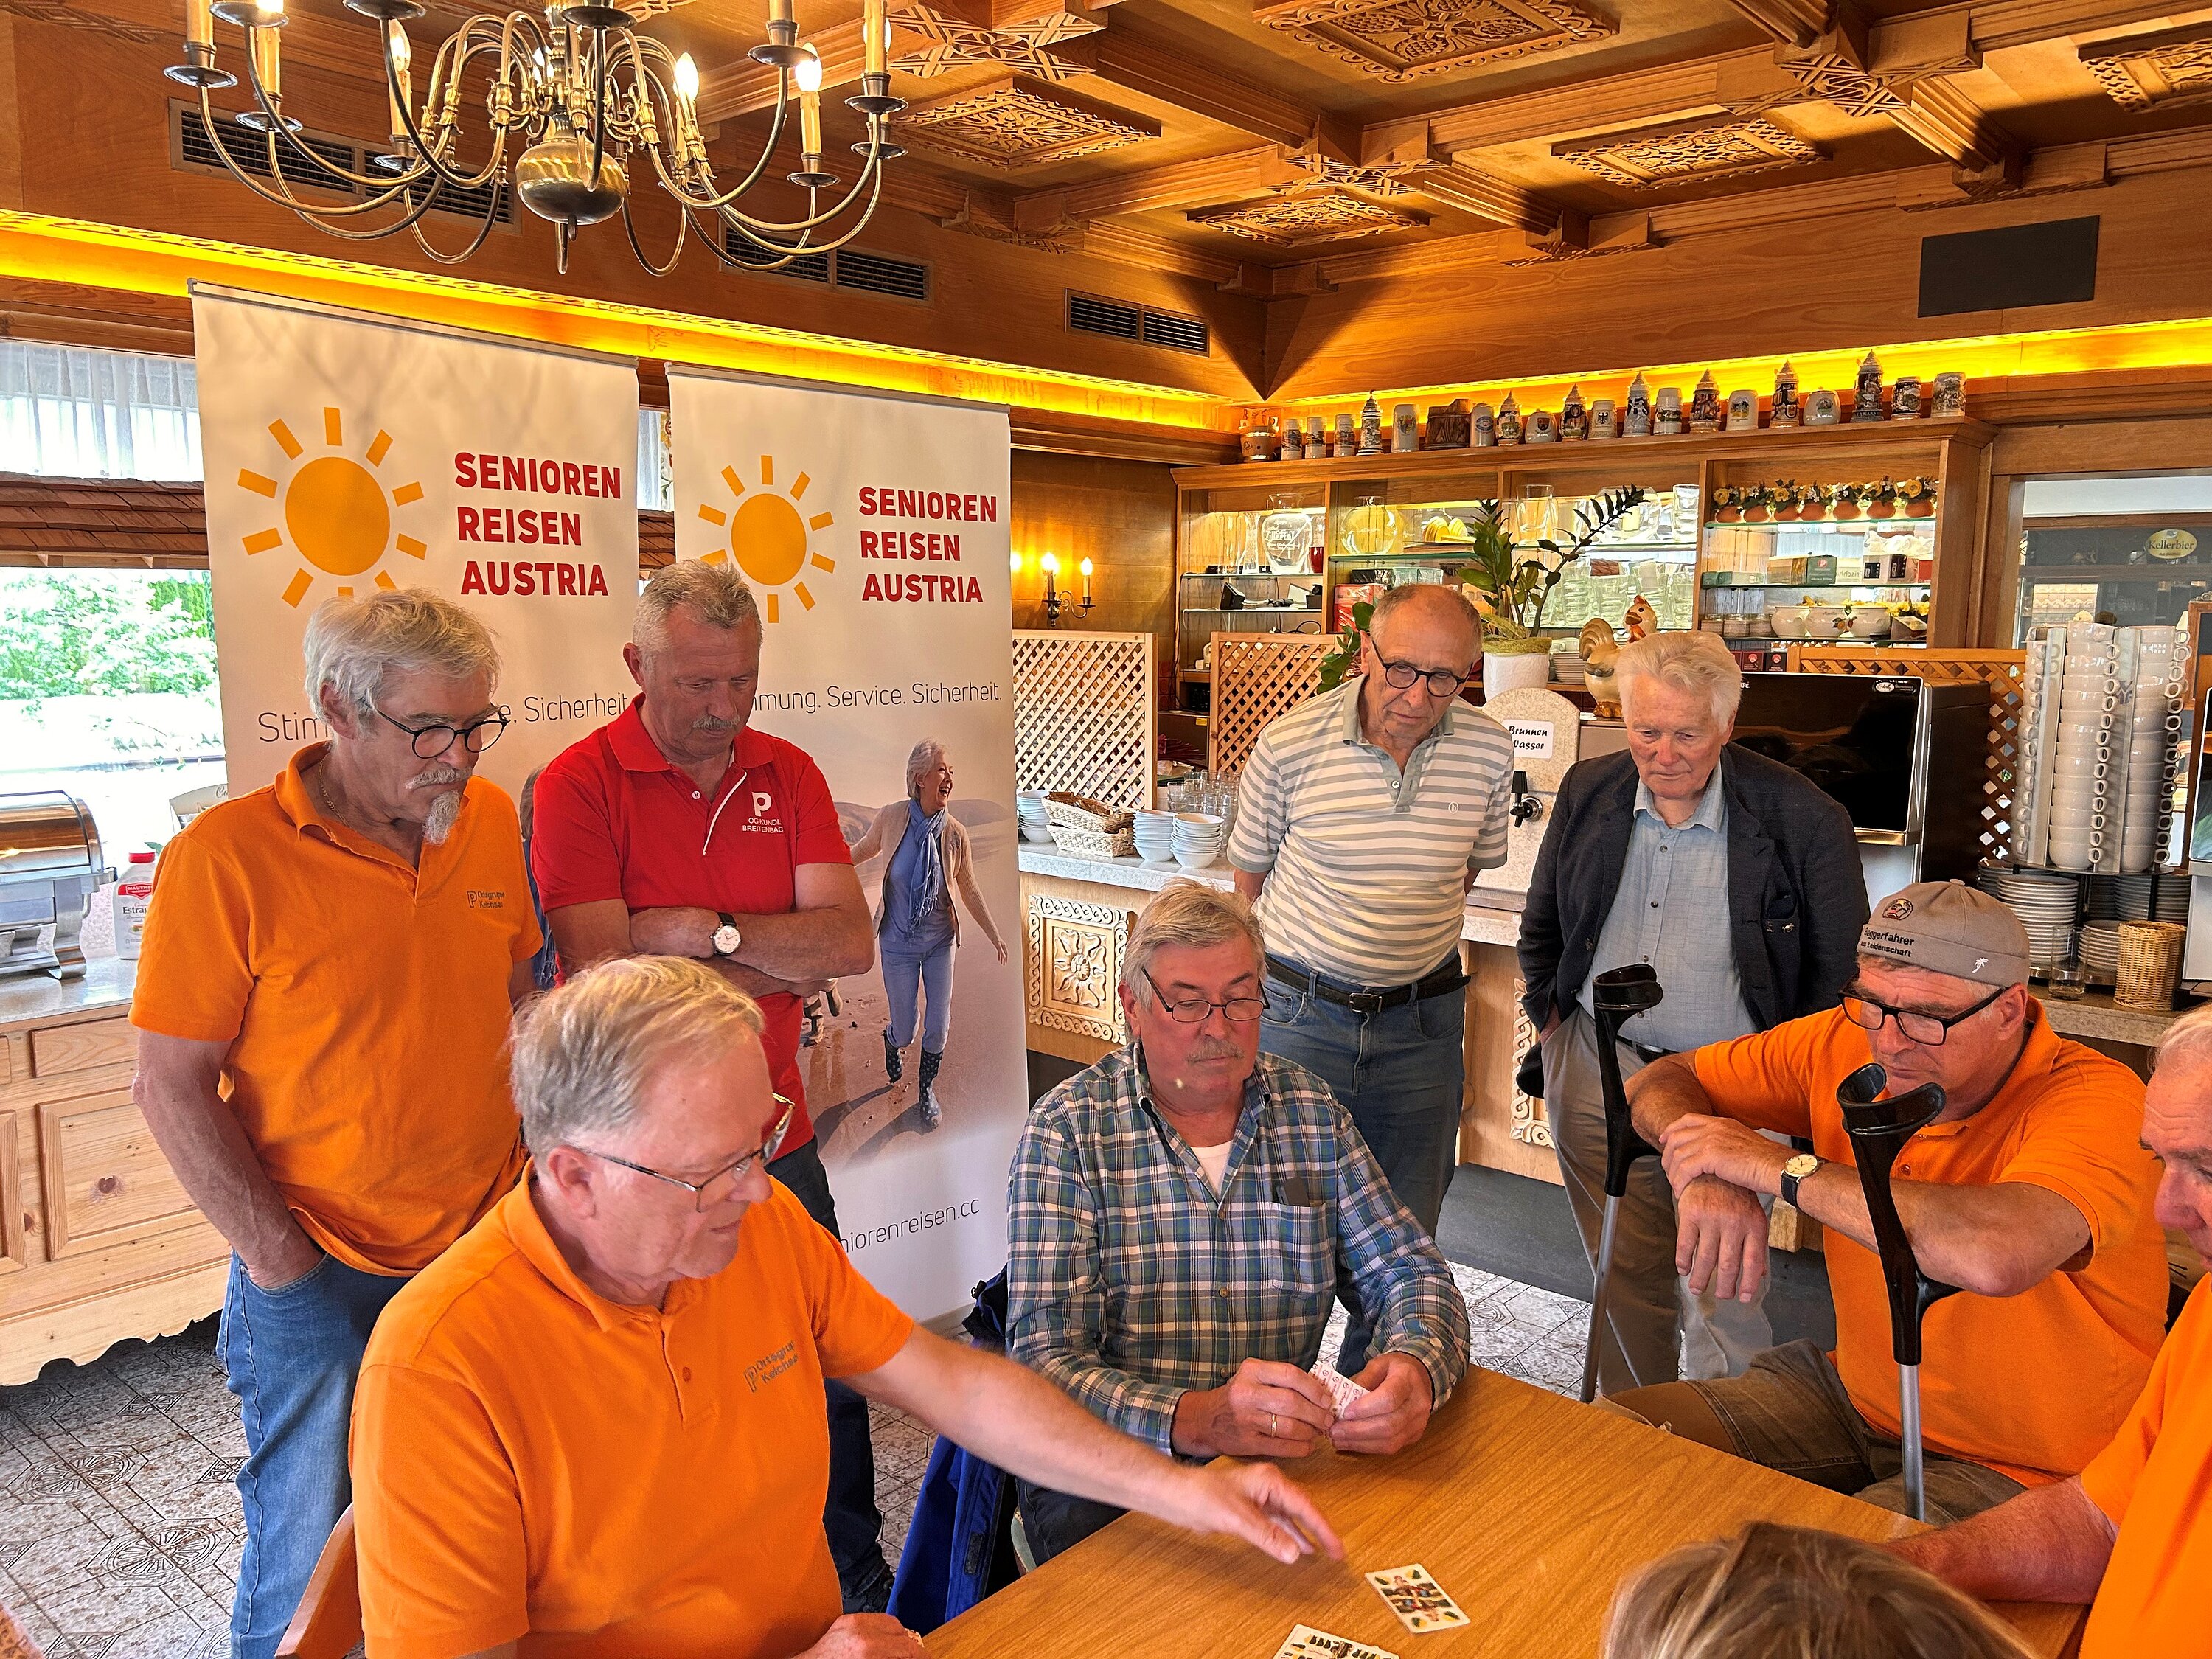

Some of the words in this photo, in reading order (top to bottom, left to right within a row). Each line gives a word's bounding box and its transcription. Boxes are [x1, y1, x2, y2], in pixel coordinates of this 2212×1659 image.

[455, 452, 621, 499] SENIOREN
[859, 487, 996, 522] SENIOREN
[457, 506, 582, 546] REISEN
[860, 530, 960, 561] REISEN
[2149, 540, 2194, 549] Kellerbier
[461, 560, 608, 596] AUSTRIA
[862, 574, 983, 602] AUSTRIA
[827, 685, 906, 707] Service.
[912, 681, 1002, 704] Sicherheit.
[1509, 726, 1548, 737] Brunnen
[751, 791, 772, 817] P
[742, 825, 784, 834] BREITENBAC
[1867, 942, 1912, 958] Leidenschaft
[840, 1199, 980, 1253] niorenreisen.cc
